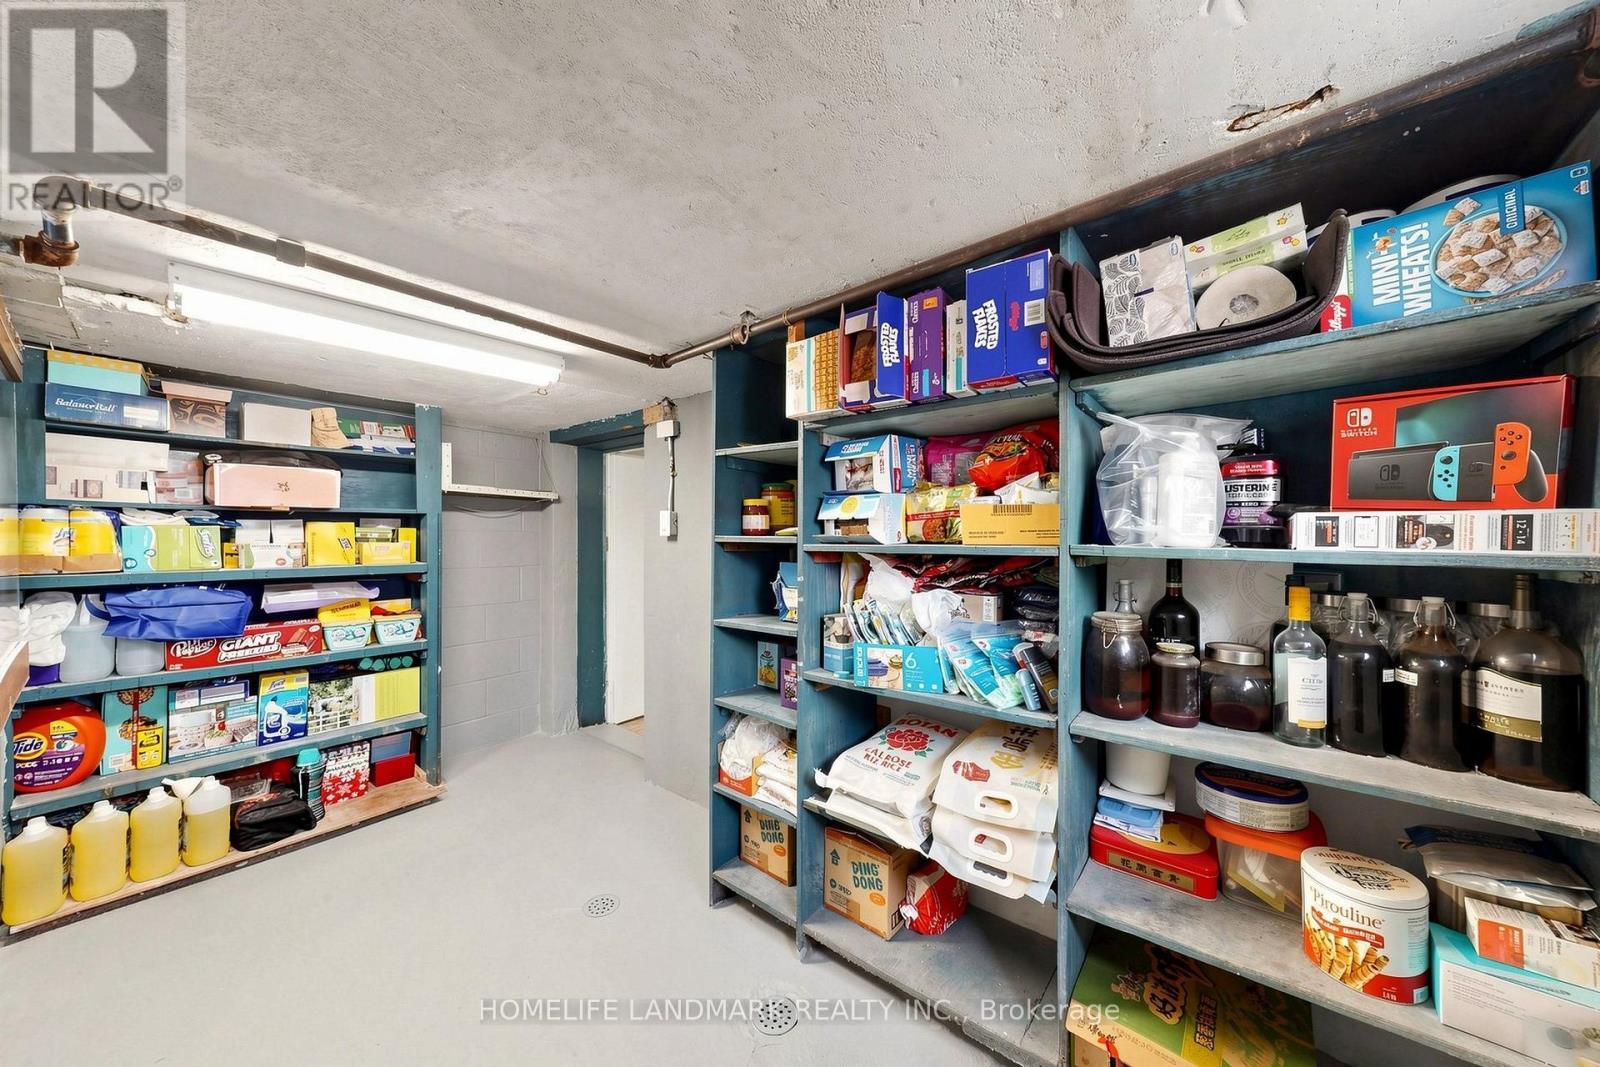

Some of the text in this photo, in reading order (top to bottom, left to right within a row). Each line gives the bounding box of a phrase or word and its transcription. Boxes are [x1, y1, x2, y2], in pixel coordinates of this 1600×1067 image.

[1504, 188, 1518, 229] ORIGINAL
[1400, 221, 1433, 317] WHEATS!
[971, 306, 989, 349] FLAKES
[982, 298, 1000, 350] FROSTED
[880, 322, 894, 368] FROSTED
[1340, 431, 1378, 439] SWITCH
[220, 632, 281, 652] GIANT
[905, 652, 917, 670] 6
[14, 740, 43, 754] Tide
[863, 753, 902, 773] RIZ RICE
[864, 747, 913, 769] CALROSE
[760, 831, 785, 844] DONG
[851, 860, 880, 876] DING
[852, 876, 884, 892] DONG
